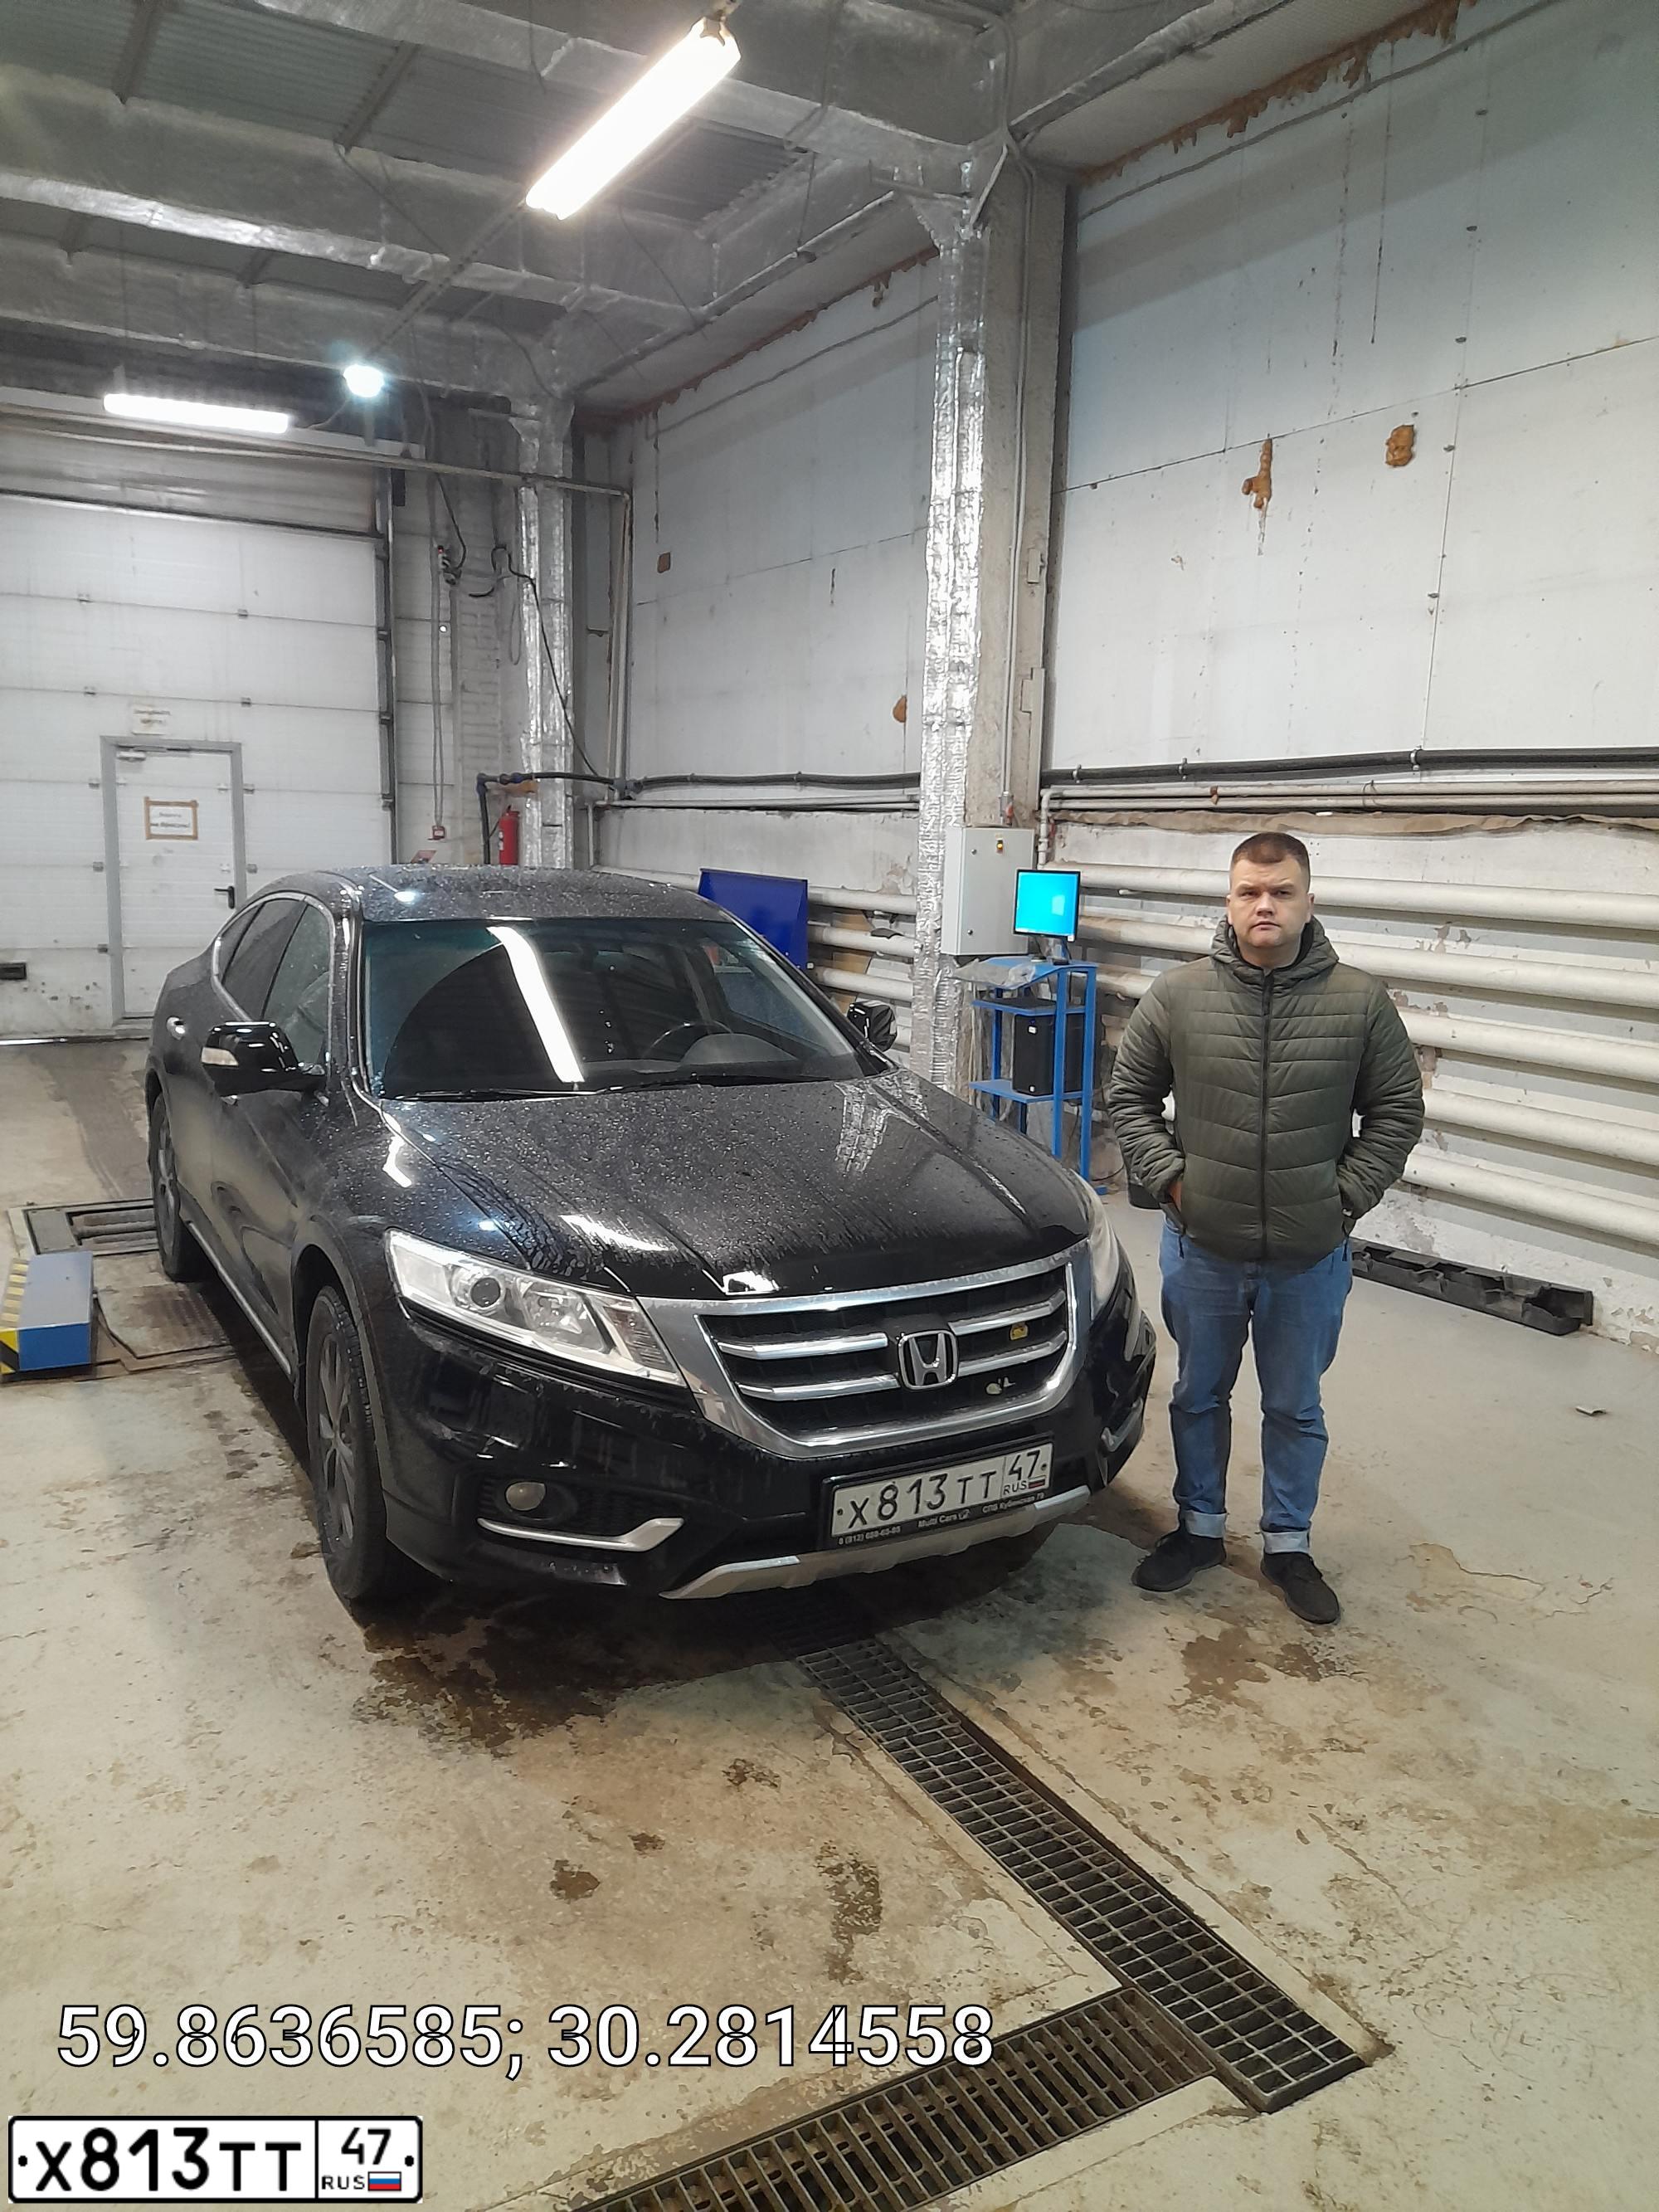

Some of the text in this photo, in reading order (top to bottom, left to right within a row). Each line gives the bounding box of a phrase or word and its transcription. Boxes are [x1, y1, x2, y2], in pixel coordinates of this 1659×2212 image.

[849, 1449, 1041, 1529] Х813ТТ 47
[1003, 1480, 1028, 1496] RUS
